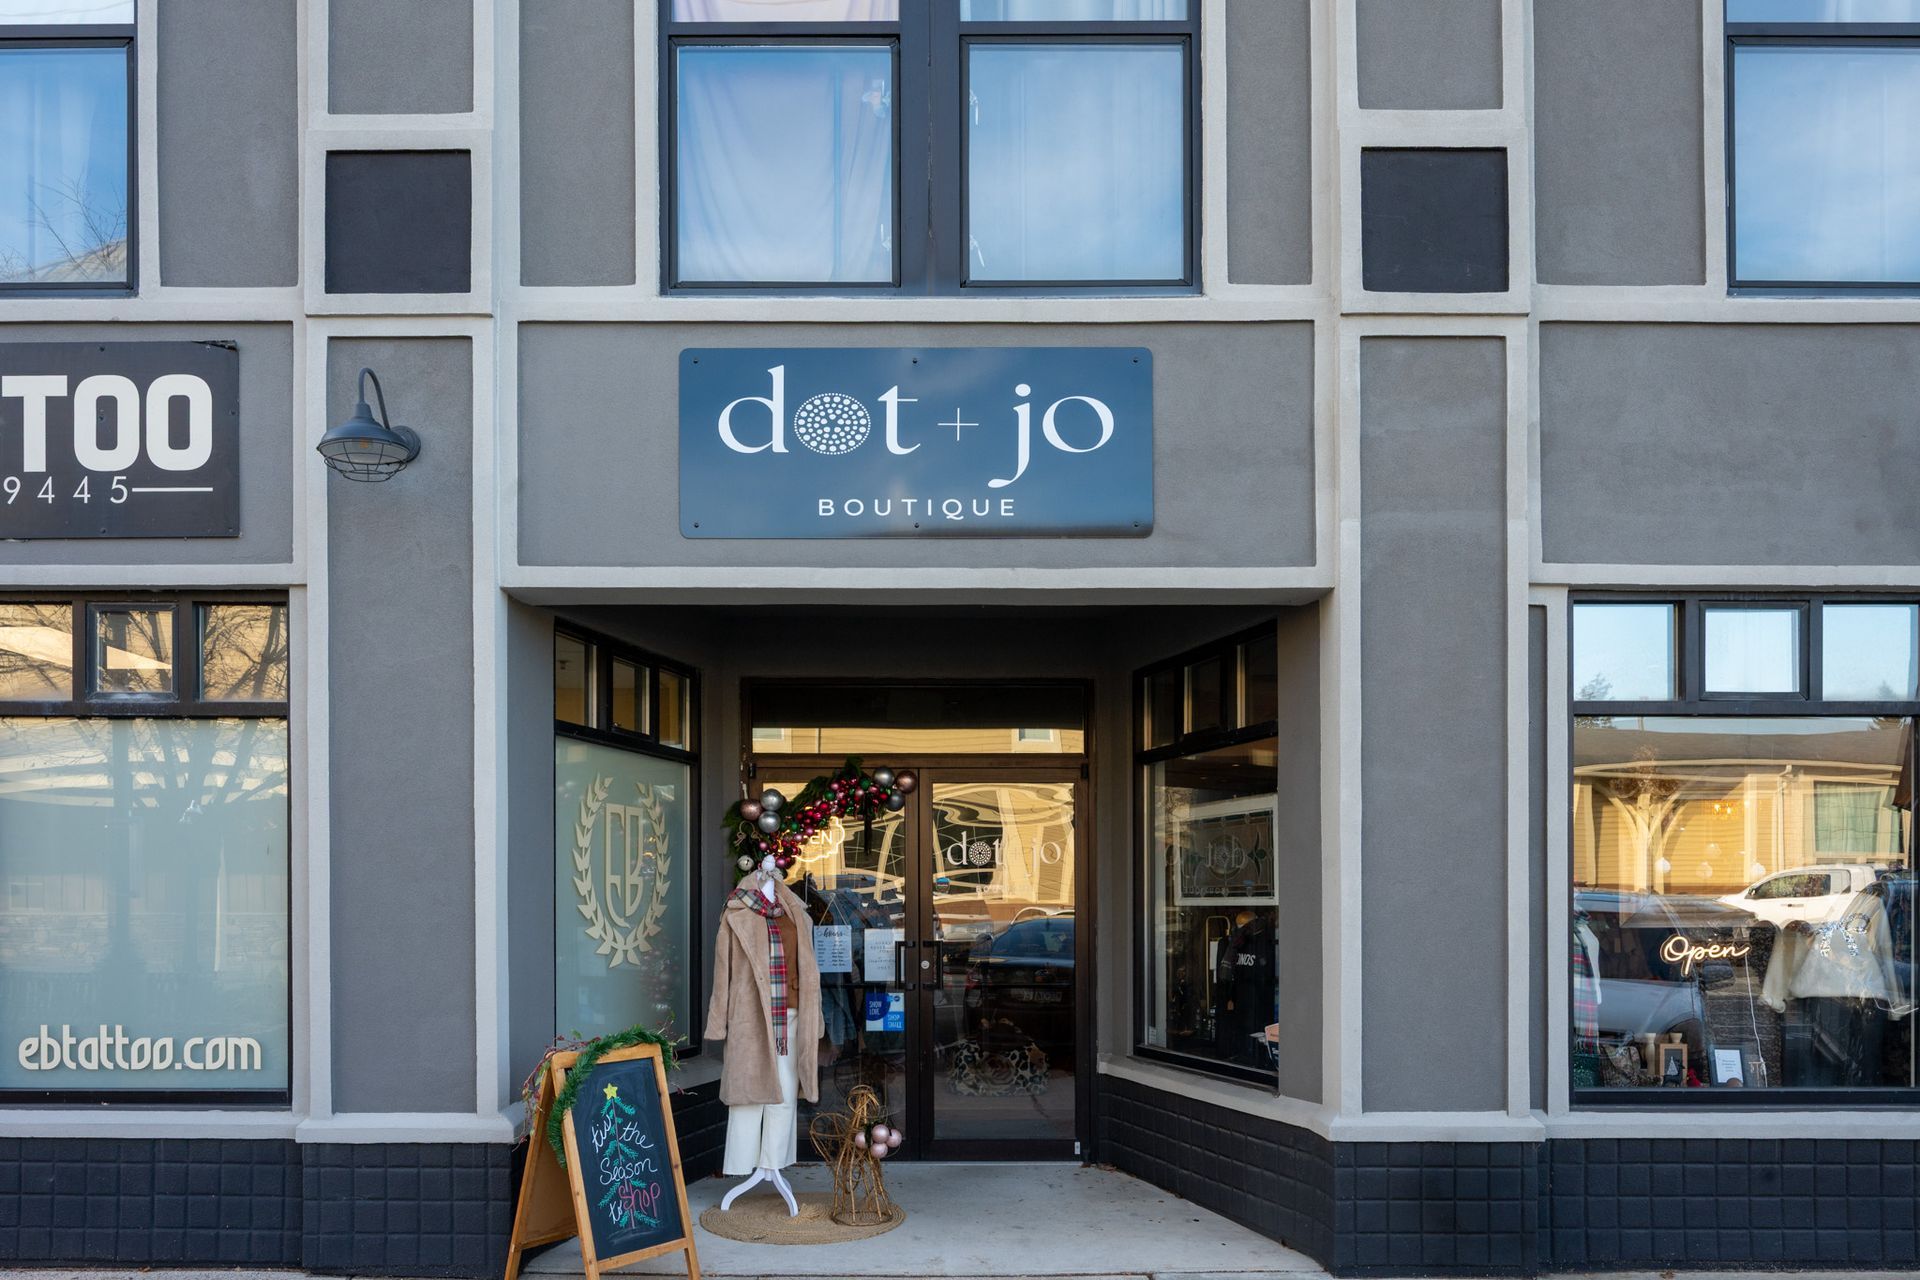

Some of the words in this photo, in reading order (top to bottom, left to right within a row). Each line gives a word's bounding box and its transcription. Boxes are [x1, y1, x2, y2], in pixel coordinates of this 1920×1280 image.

[1, 374, 213, 472] TOO
[718, 364, 921, 455] dot
[988, 383, 1115, 488] jo
[818, 499, 1015, 521] BOUTIQUE
[946, 830, 1004, 867] dot
[1662, 935, 1751, 976] Open
[18, 1024, 262, 1071] ebtattoo.com
[619, 1121, 655, 1149] the
